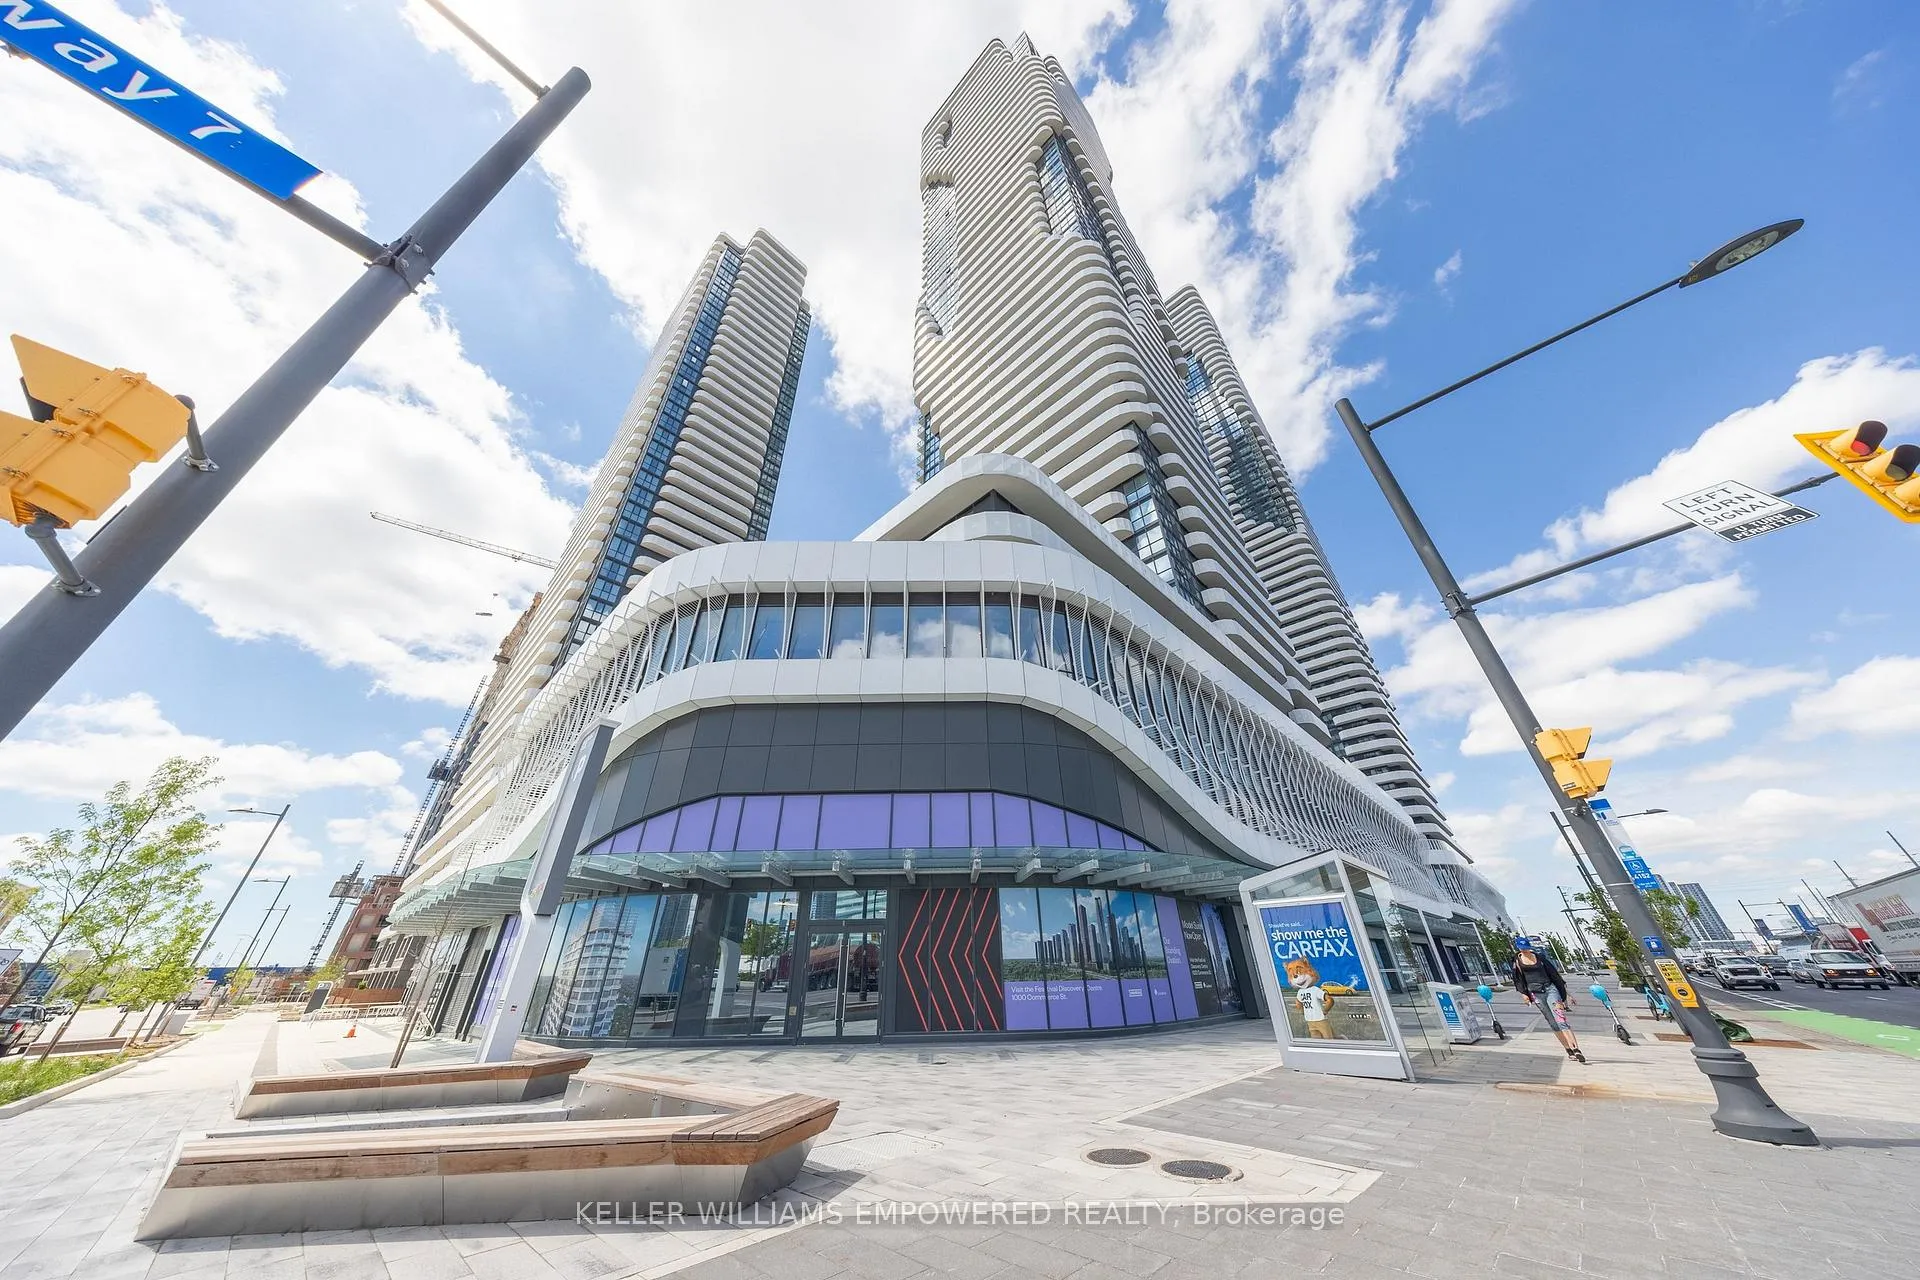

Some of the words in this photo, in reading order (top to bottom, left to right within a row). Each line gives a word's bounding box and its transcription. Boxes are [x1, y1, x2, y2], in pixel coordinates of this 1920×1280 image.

[190, 111, 243, 140] 7
[1680, 487, 1732, 508] LEFT
[1691, 493, 1755, 516] TURN
[1703, 500, 1779, 526] SIGNAL
[1736, 525, 1747, 533] U
[1749, 513, 1787, 528] TURN
[1733, 514, 1806, 540] PERMITTED
[1271, 929, 1302, 941] show
[1304, 930, 1324, 940] me
[1325, 926, 1348, 938] the
[1274, 938, 1354, 959] CARFAX
